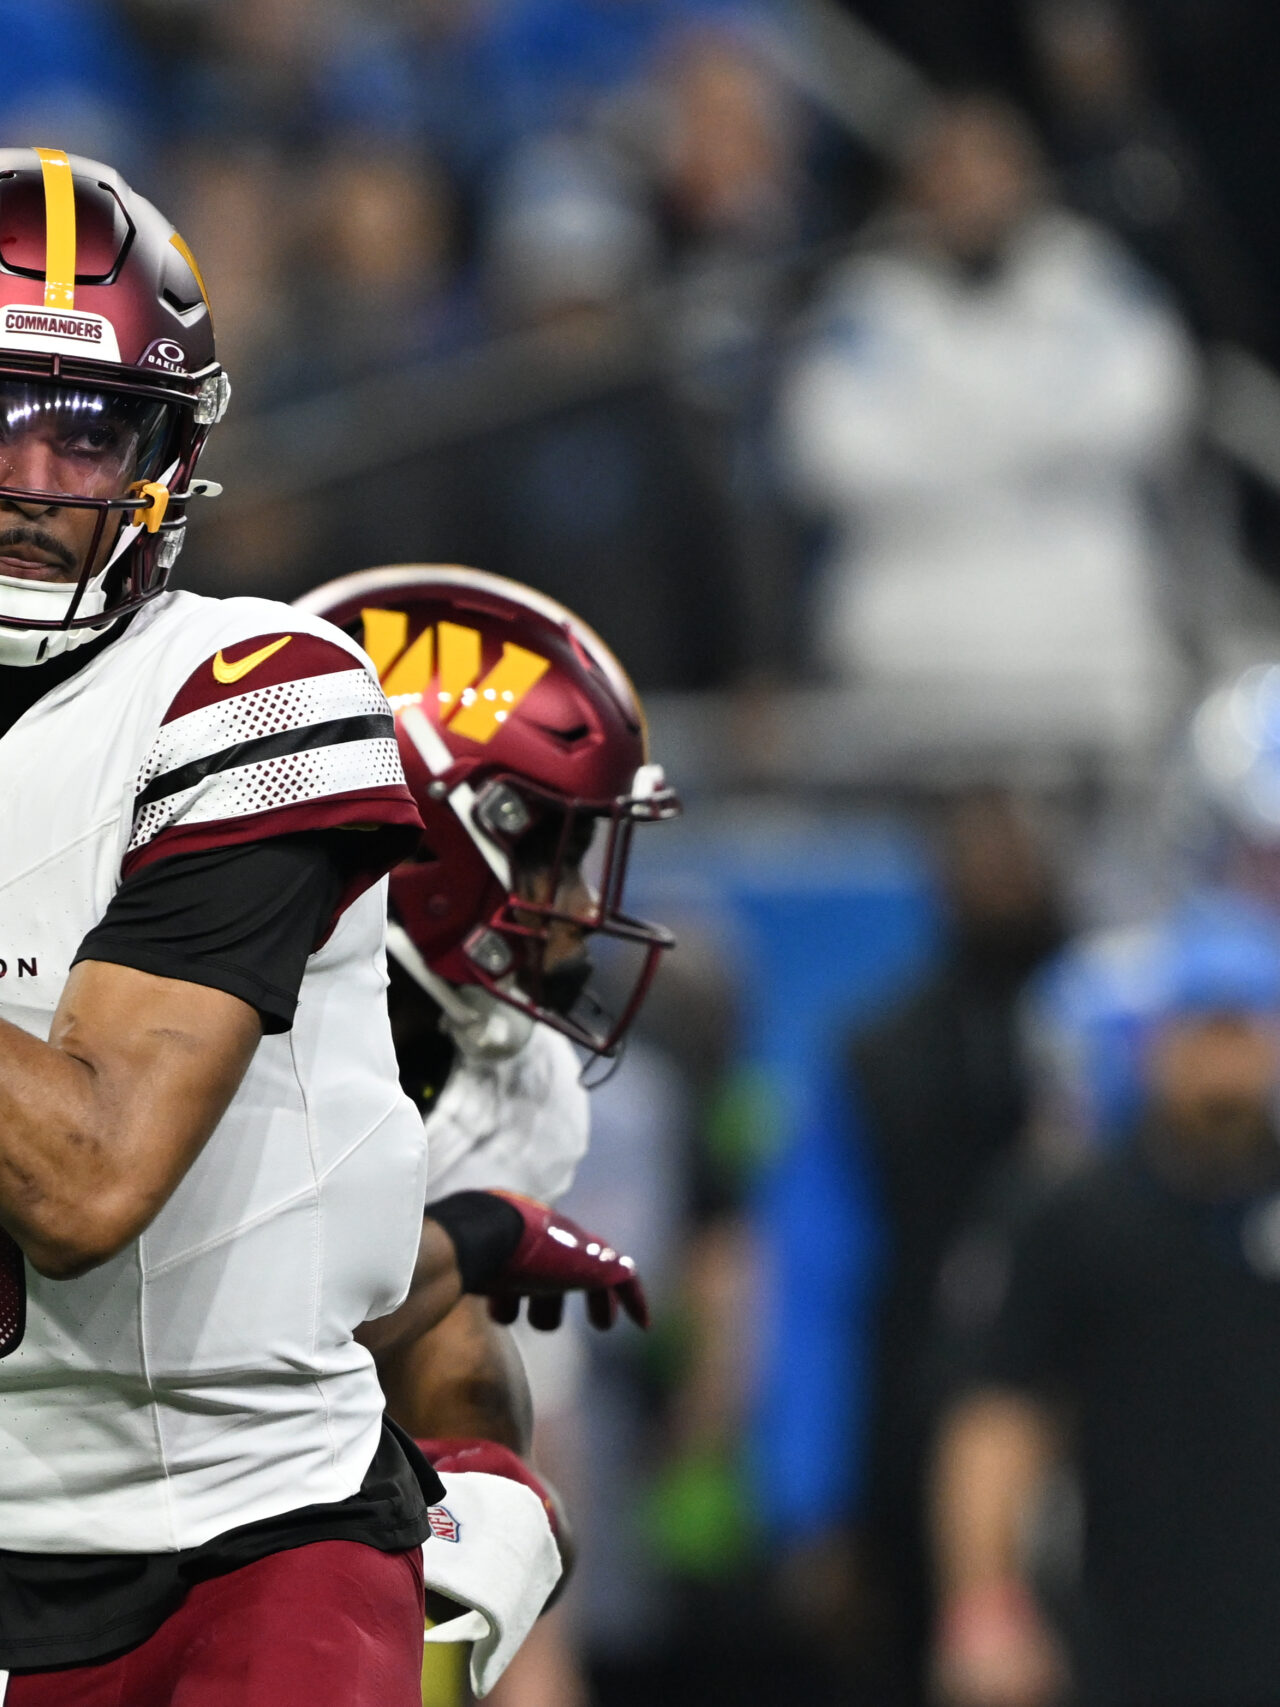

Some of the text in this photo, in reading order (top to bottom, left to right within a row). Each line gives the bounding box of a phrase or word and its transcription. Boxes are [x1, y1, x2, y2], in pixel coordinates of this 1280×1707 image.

[5, 314, 103, 340] COMMANDERS
[148, 355, 187, 374] OAKLEY
[427, 1508, 455, 1540] NFL
